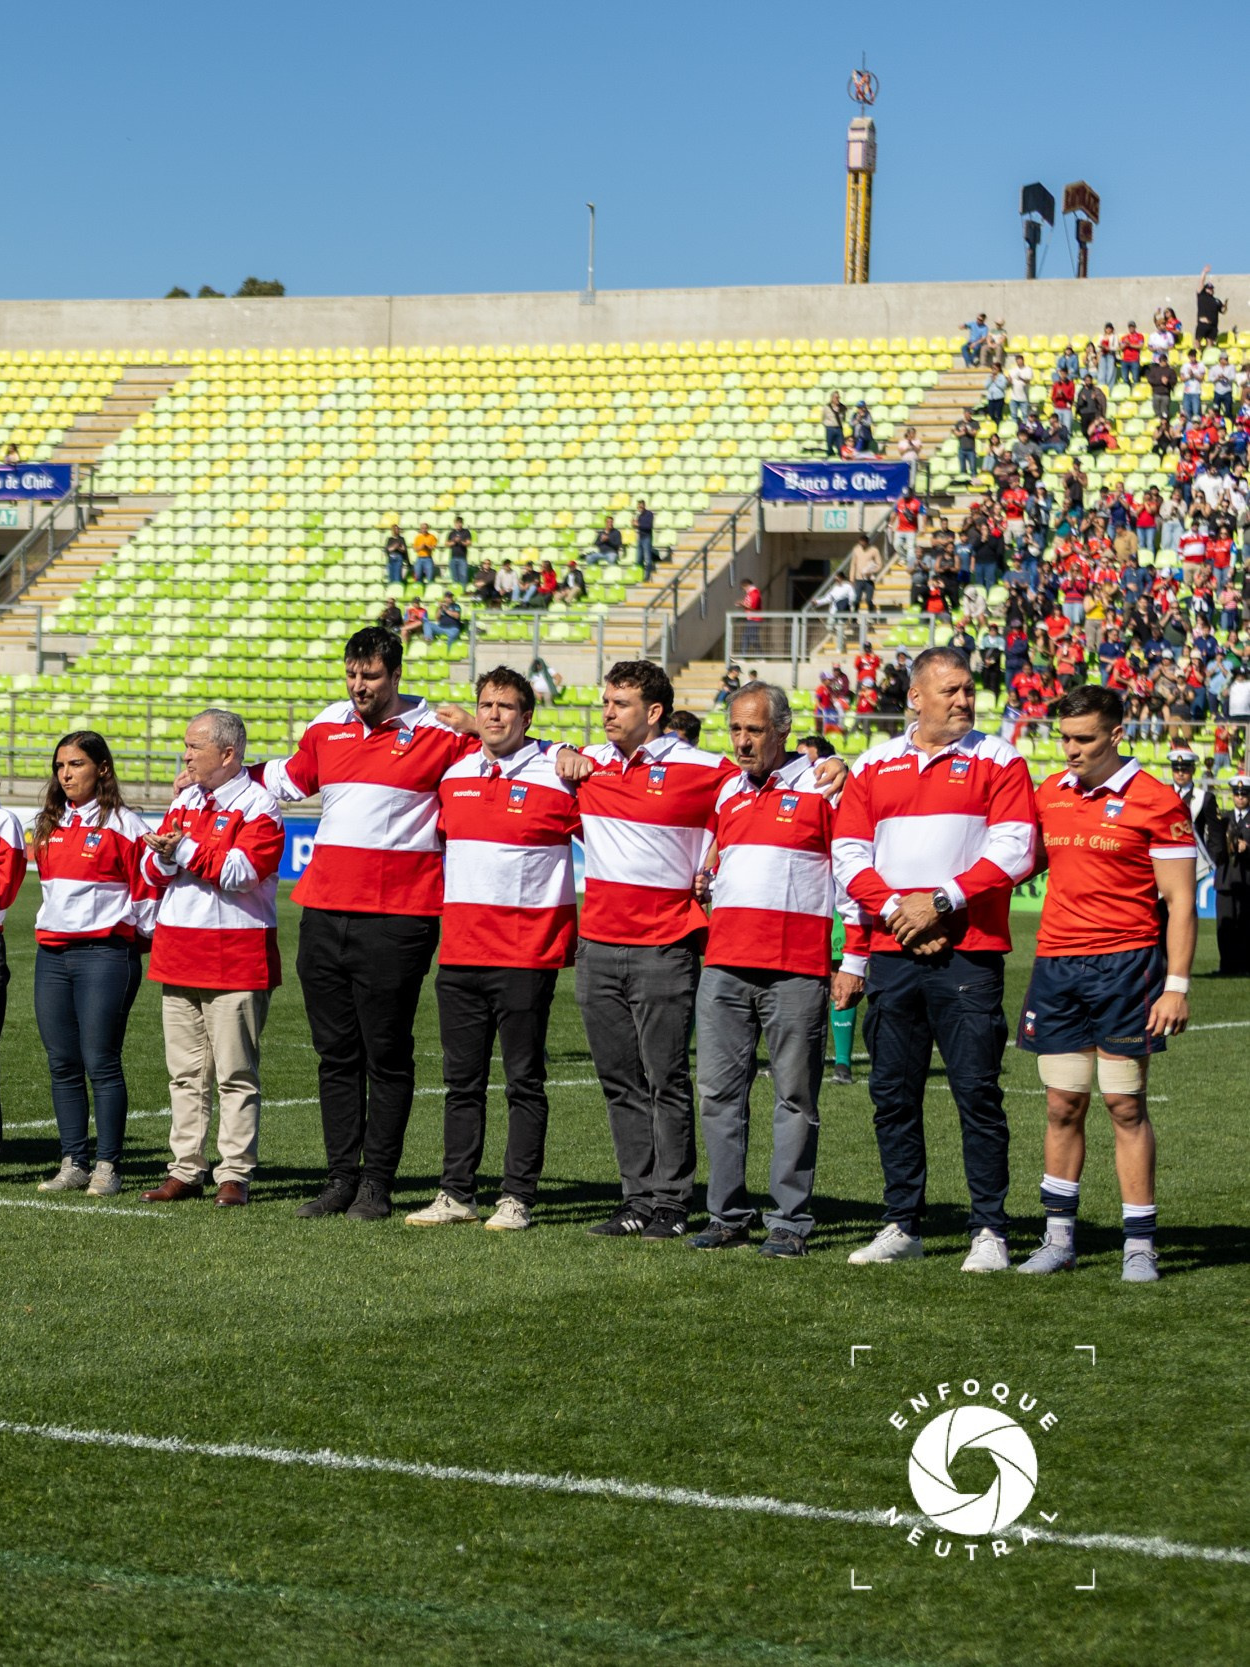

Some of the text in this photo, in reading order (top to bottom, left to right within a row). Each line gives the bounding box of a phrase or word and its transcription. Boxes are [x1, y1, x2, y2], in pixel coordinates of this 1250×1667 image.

[5, 473, 19, 490] de
[21, 472, 54, 491] Chile
[784, 471, 888, 492] Banco de Chile
[0, 510, 18, 525] A7
[825, 512, 846, 528] A6
[1046, 801, 1074, 810] marathon
[1043, 832, 1122, 852] Banco de Chile
[1104, 1036, 1144, 1044] marathon
